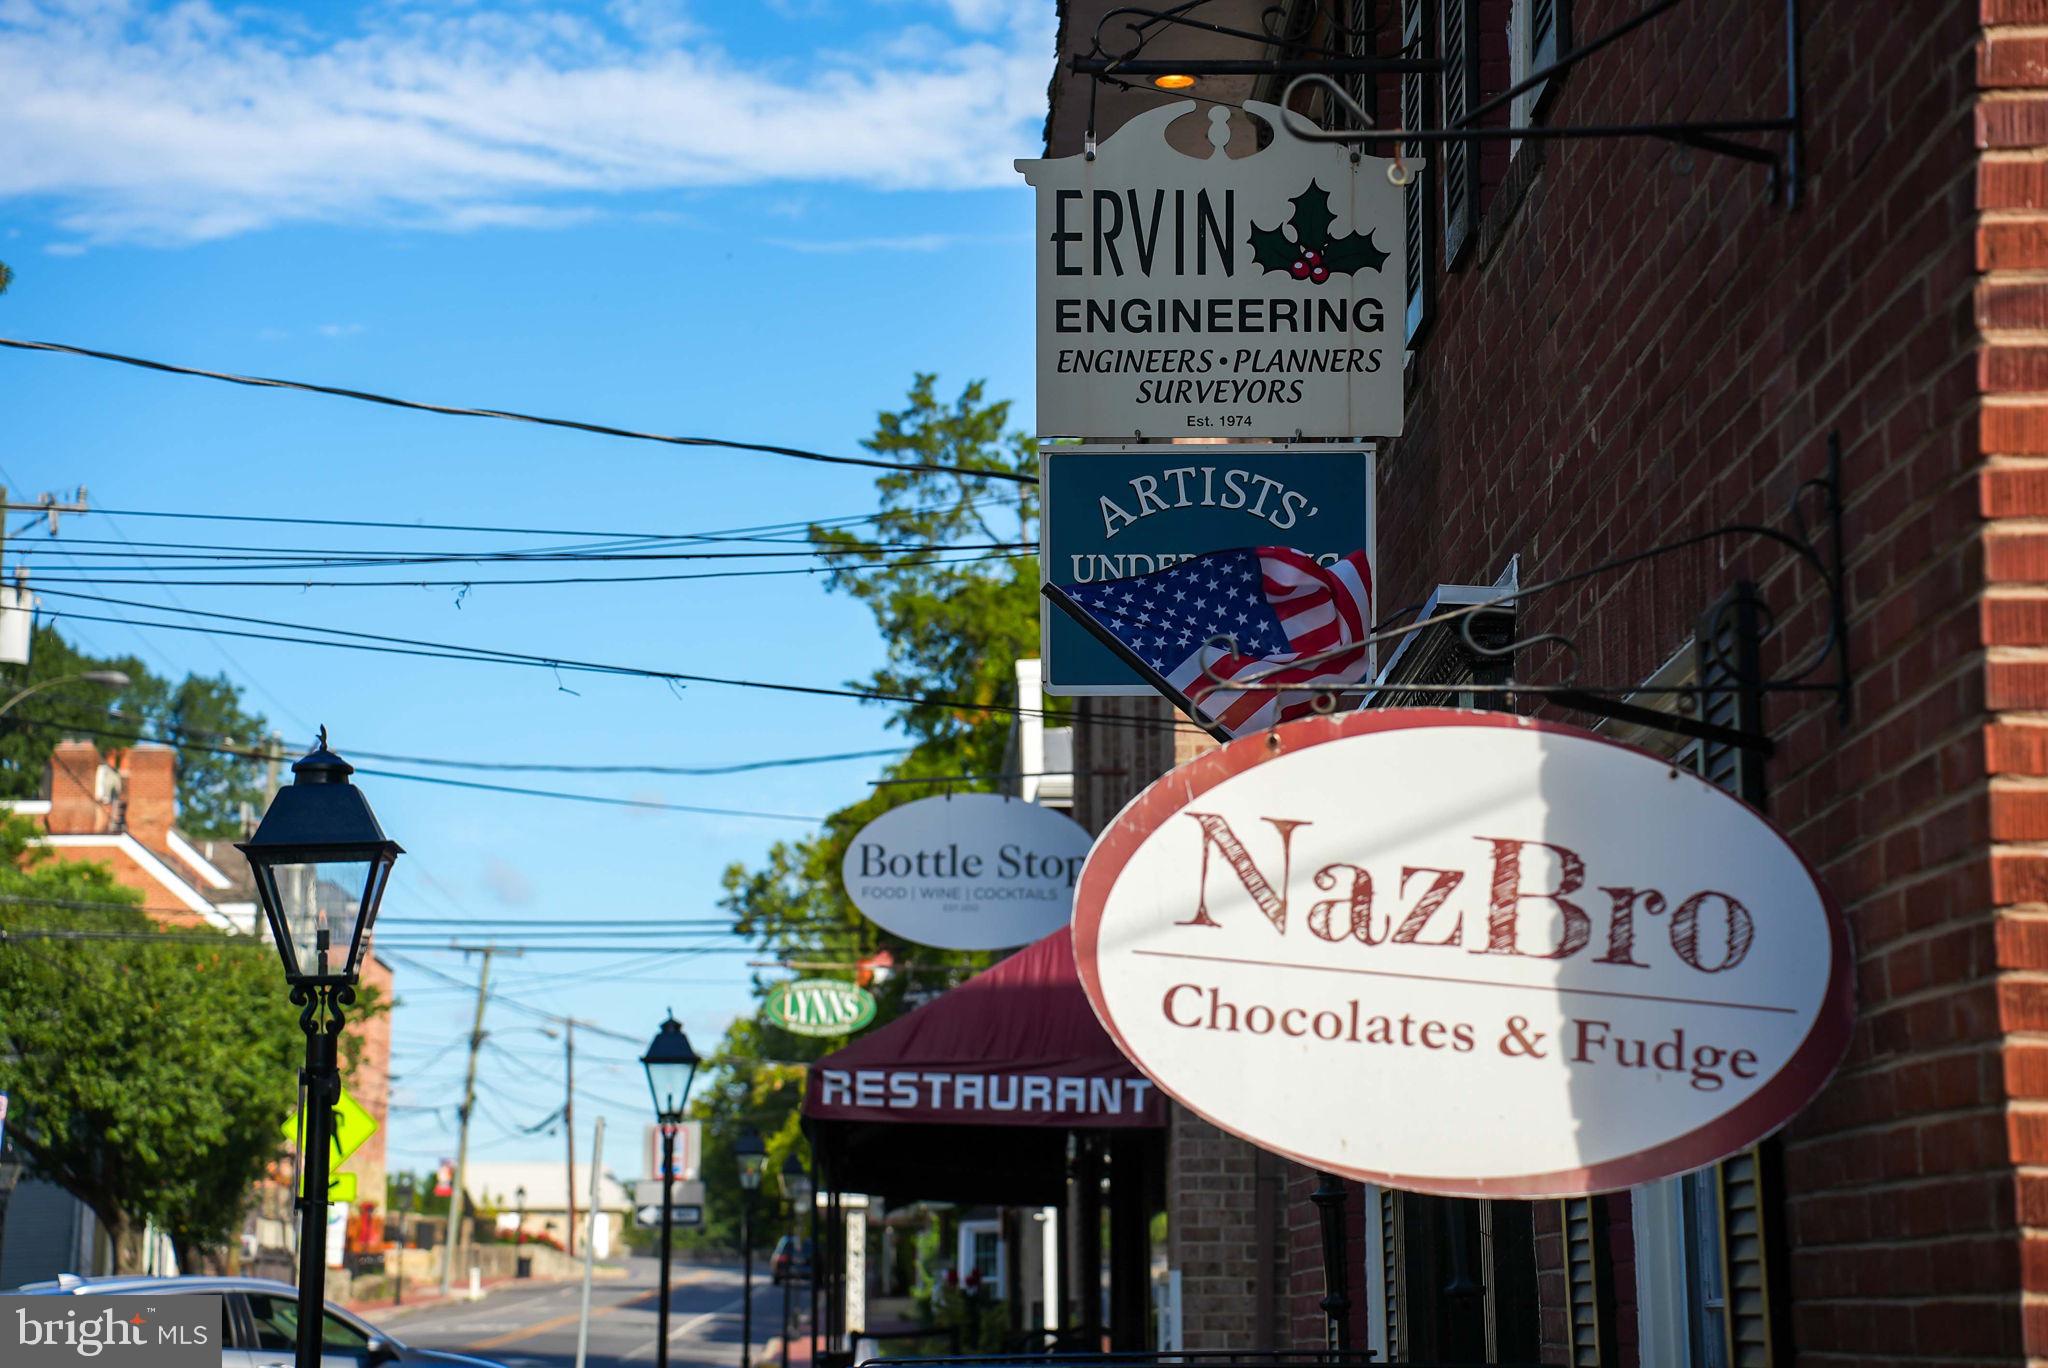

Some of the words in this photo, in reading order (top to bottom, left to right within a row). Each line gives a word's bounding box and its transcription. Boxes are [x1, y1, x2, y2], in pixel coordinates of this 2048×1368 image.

[1051, 188, 1234, 277] ERVIN
[1056, 298, 1384, 333] ENGINEERING
[1057, 349, 1213, 373] ENGINEERS
[1233, 349, 1382, 373] PLANNERS
[1135, 379, 1304, 404] SURVEYORS
[1187, 416, 1213, 427] Est.
[1220, 415, 1252, 427] 1974
[860, 844, 983, 878] Bottle
[862, 887, 907, 899] FOOD
[921, 887, 960, 899] WINE
[973, 887, 1058, 900] COCKTAILS
[1174, 812, 1755, 973] NazBro
[1162, 984, 1475, 1052] Chocolates
[1498, 1015, 1547, 1059] &
[1571, 1018, 1758, 1092] Fudge
[821, 1069, 1153, 1114] RESTAURANT
